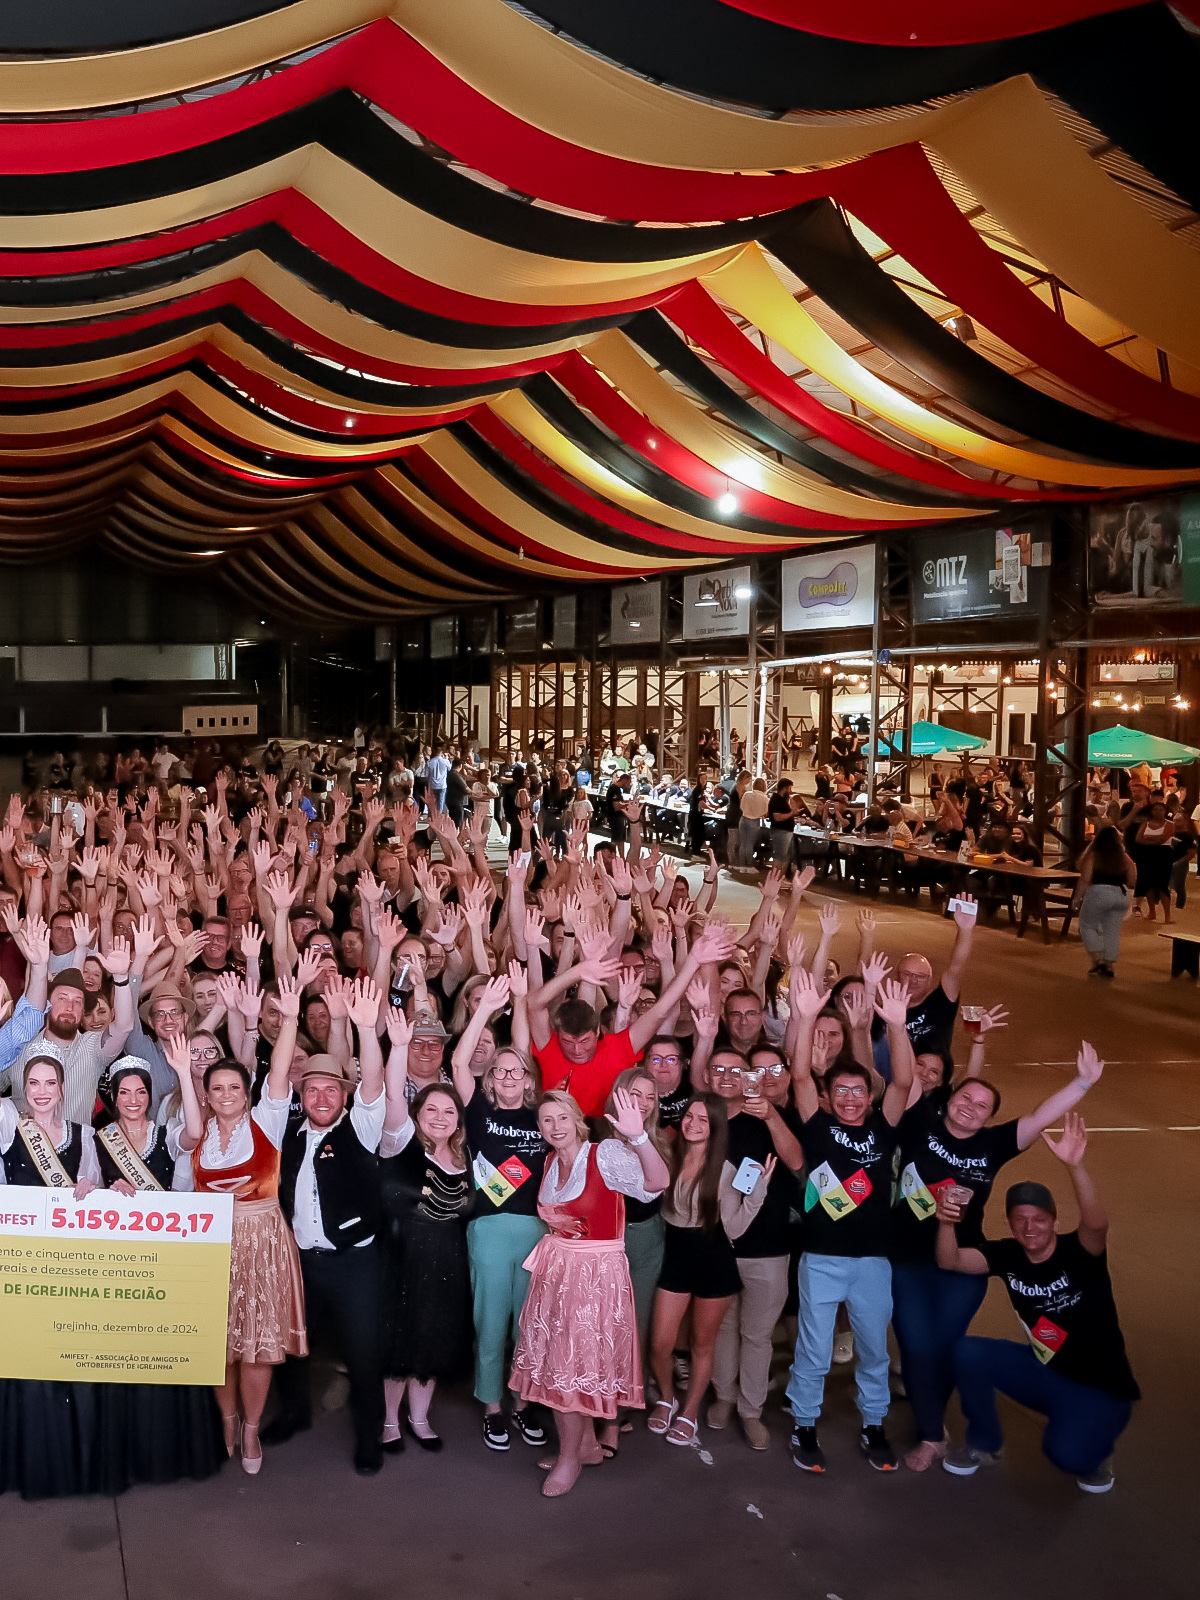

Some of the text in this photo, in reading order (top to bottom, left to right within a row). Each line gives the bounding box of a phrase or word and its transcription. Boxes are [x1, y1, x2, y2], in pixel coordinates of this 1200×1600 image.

[936, 555, 968, 588] MTZ
[27, 1133, 52, 1172] Rainha
[117, 1146, 146, 1186] Princesa
[51, 1208, 214, 1238] 5.159.202,17
[26, 1250, 33, 1258] e
[35, 1249, 94, 1261] cinquenta
[98, 1253, 105, 1261] e
[108, 1253, 137, 1262] nove
[140, 1252, 158, 1263] mil
[0, 1263, 28, 1274] reais
[31, 1266, 38, 1274] e
[41, 1264, 99, 1277] dezessete
[102, 1268, 155, 1279] centavos
[4, 1283, 22, 1295] DE
[25, 1285, 100, 1299] IGREJINHA
[103, 1288, 111, 1299] E
[114, 1286, 167, 1301] REGIÃO
[53, 1320, 198, 1334] Igrejinha, dezembro de 2024
[95, 1353, 139, 1362] ASSOCIAÇÃO
